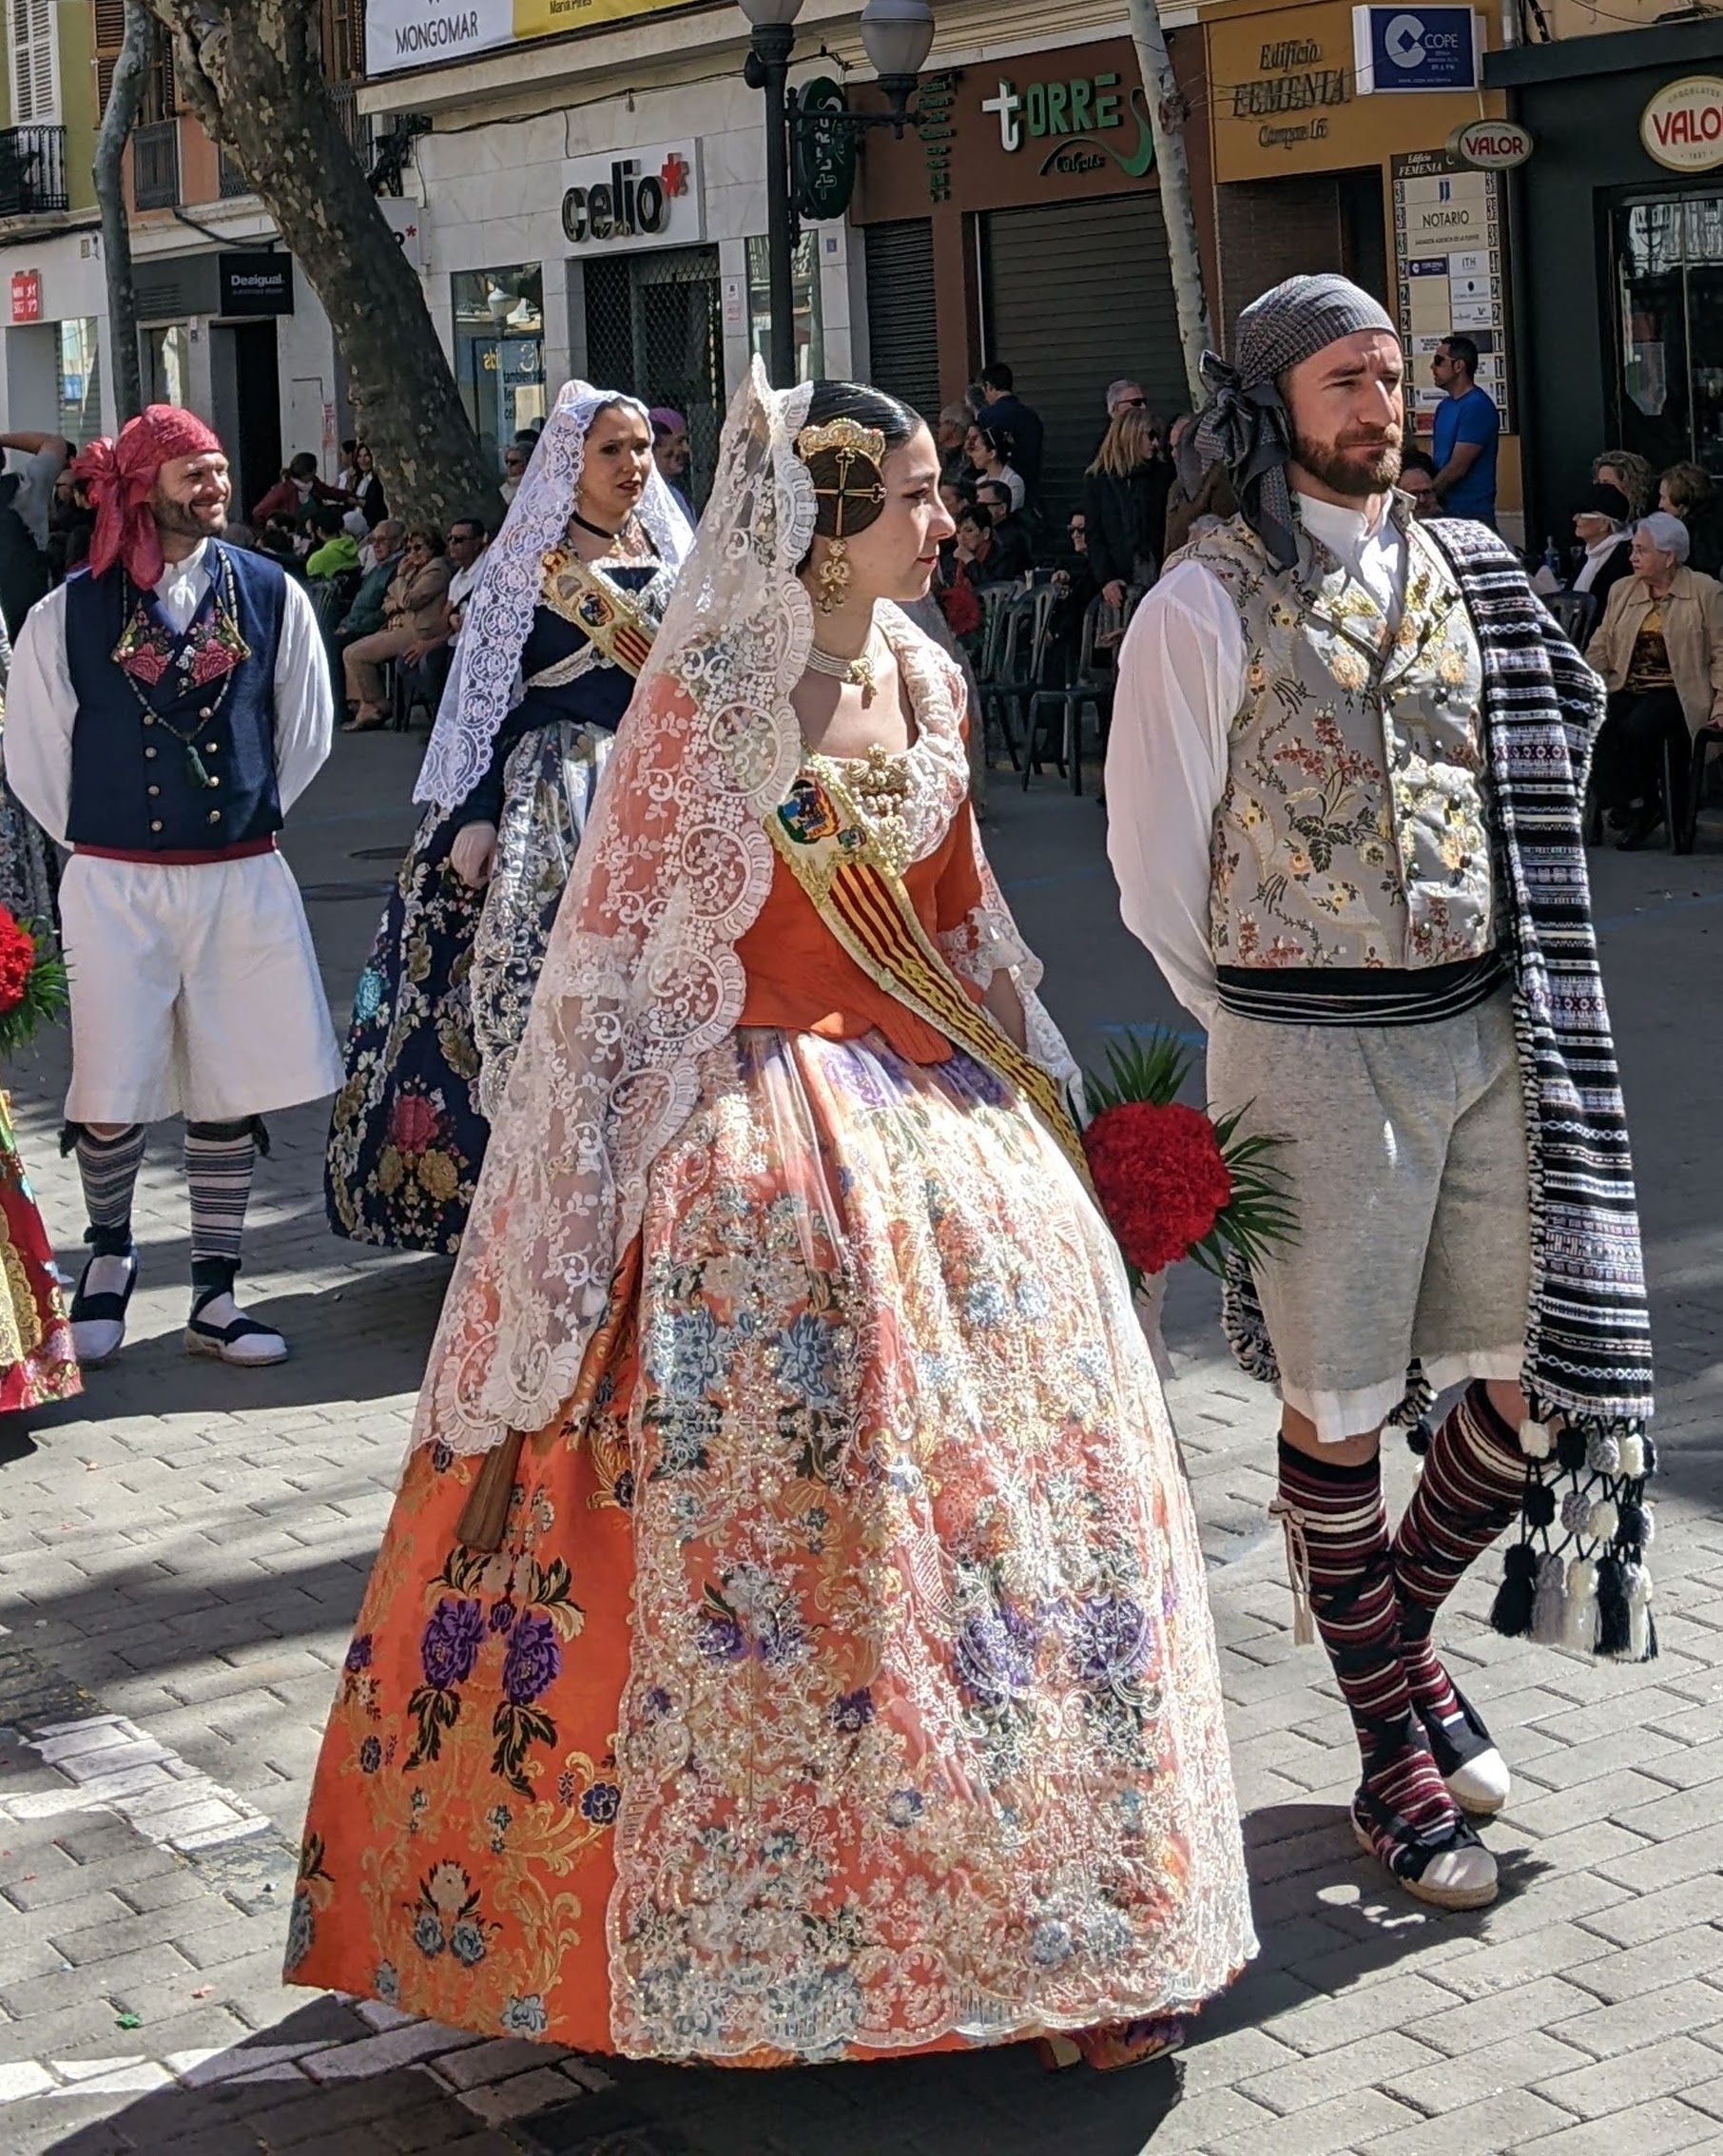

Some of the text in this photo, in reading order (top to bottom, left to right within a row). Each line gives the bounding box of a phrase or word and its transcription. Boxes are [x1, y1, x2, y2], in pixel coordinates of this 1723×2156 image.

[396, 10, 478, 54] MONGOMAR
[1424, 33, 1458, 49] COPE
[1260, 38, 1323, 73] Edificio
[1309, 117, 1329, 139] 16
[1651, 107, 1723, 146] VALO
[1465, 136, 1524, 157] VALOR
[1399, 162, 1442, 178] FEMENIA
[562, 159, 671, 243] celio
[1423, 210, 1470, 228] NOTARIO
[1462, 257, 1477, 267] ITH
